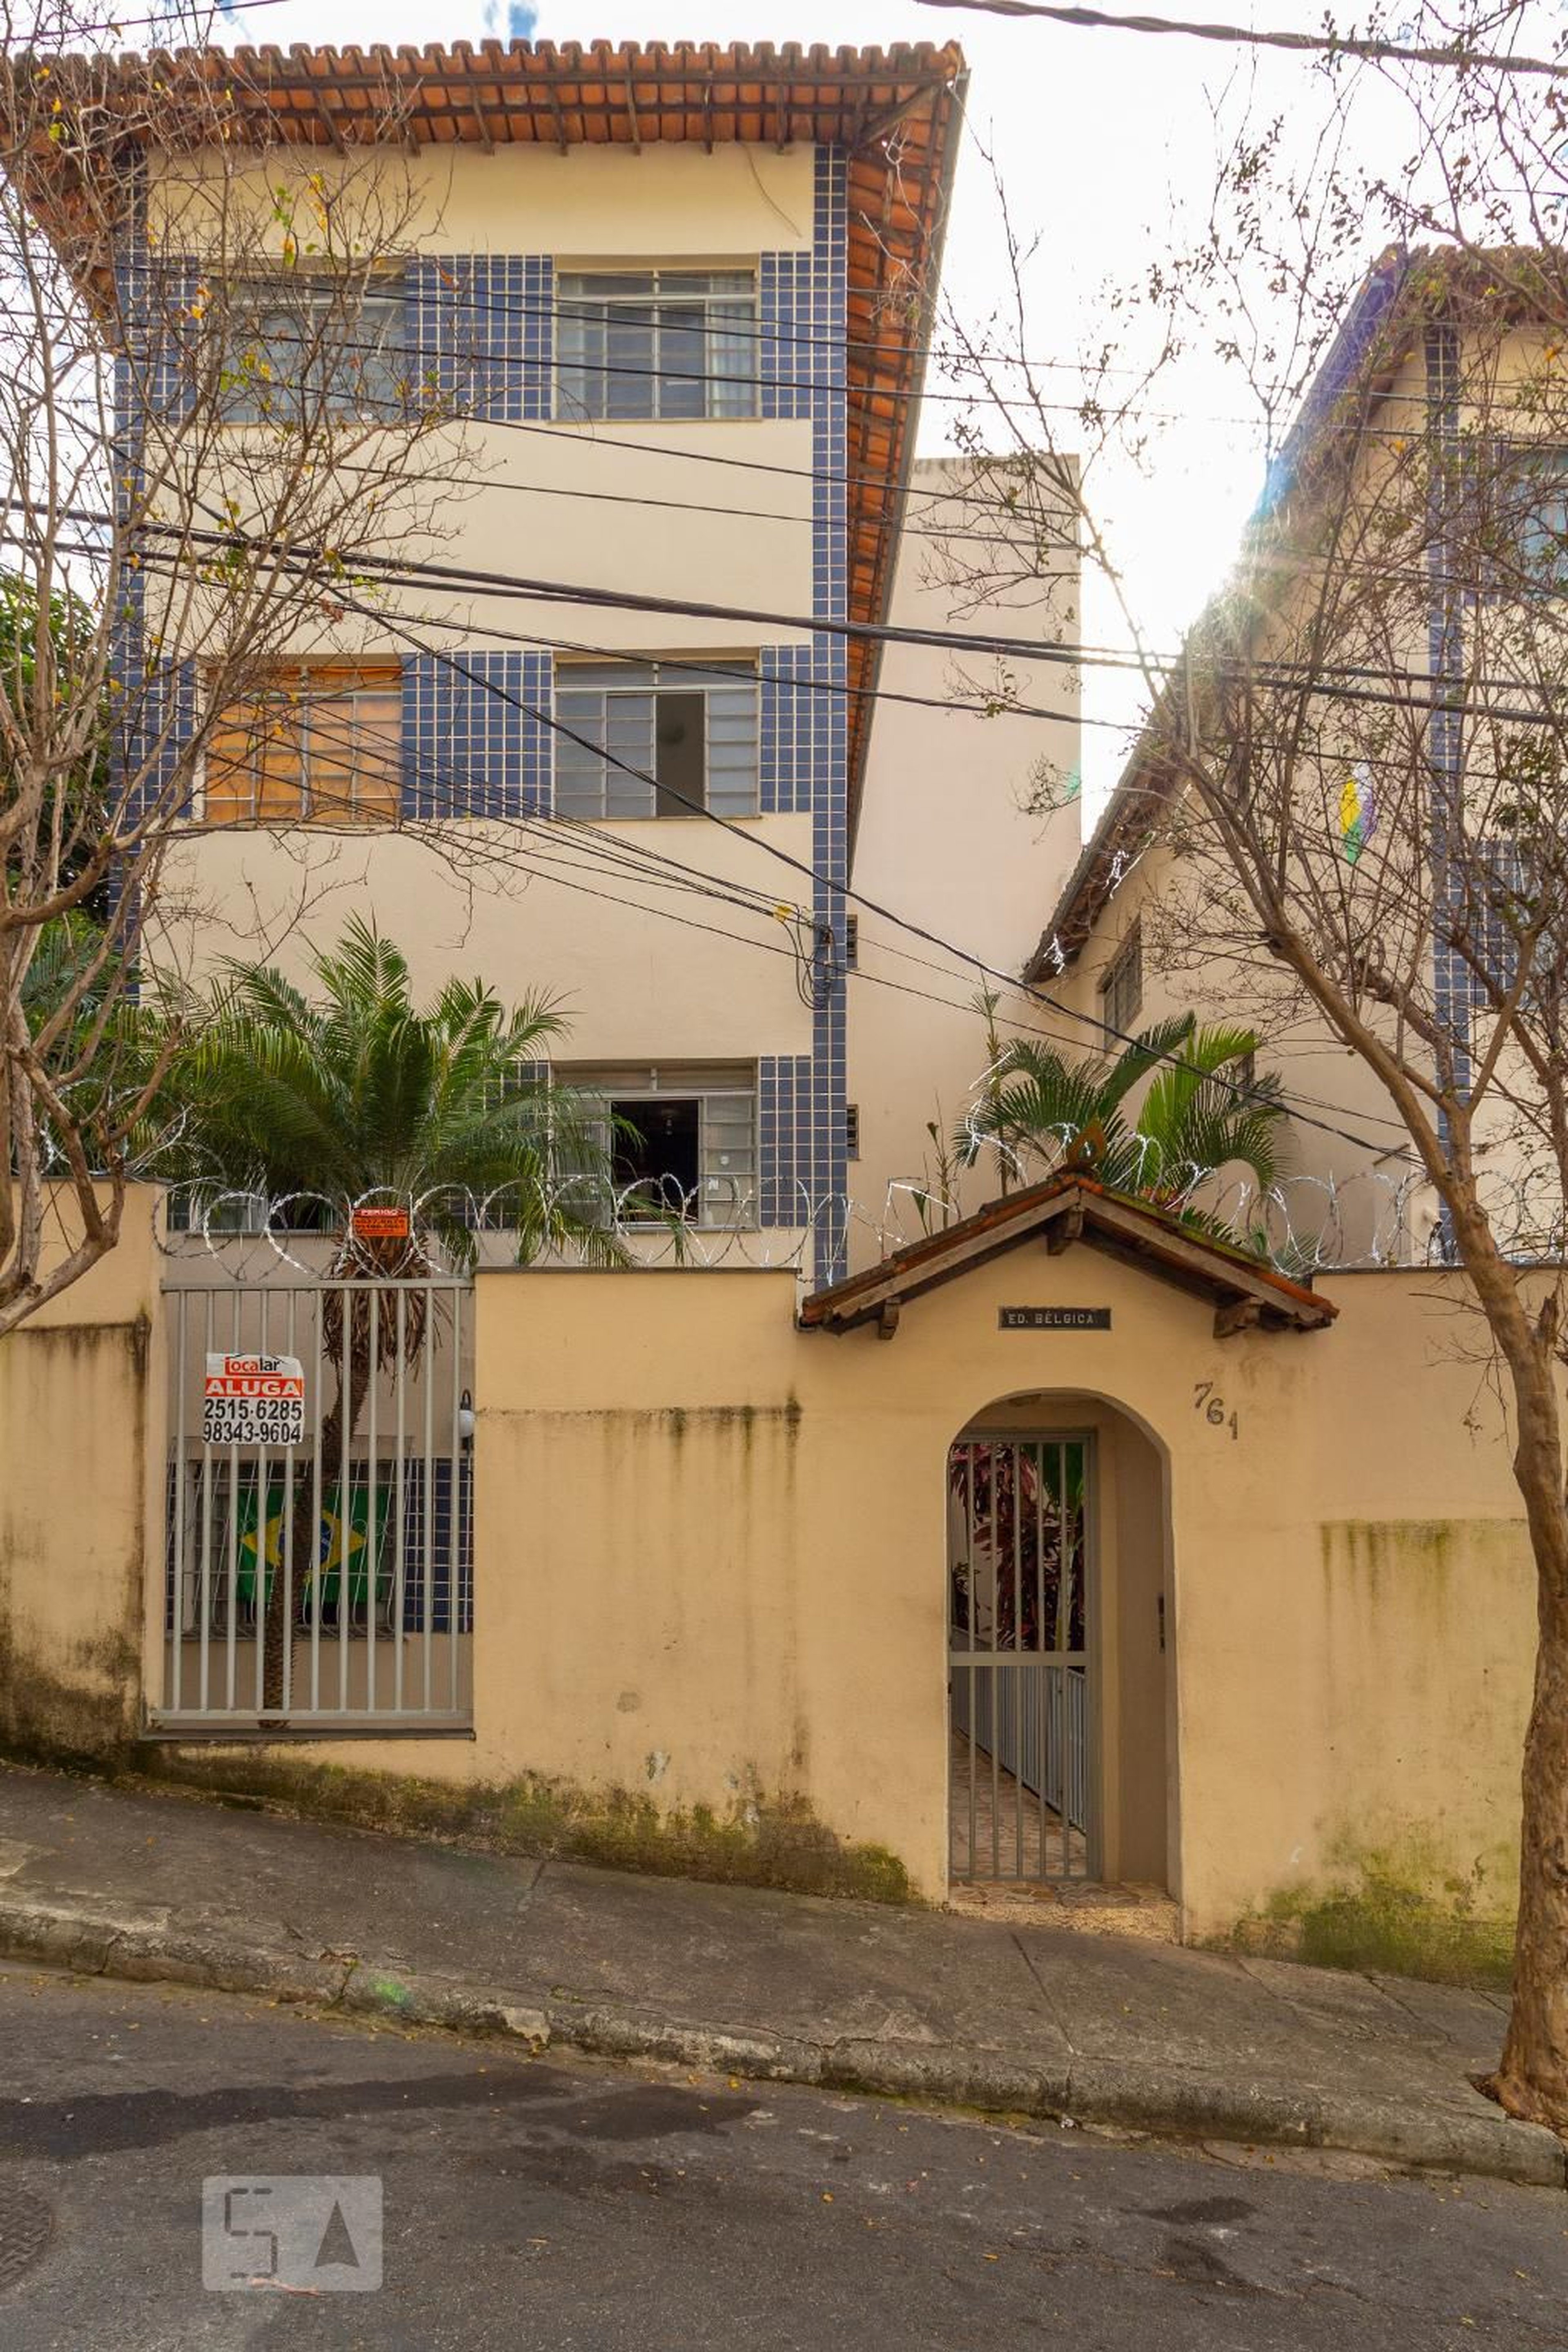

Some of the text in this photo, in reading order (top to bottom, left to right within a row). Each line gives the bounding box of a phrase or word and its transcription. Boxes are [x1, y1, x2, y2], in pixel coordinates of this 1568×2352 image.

[1009, 1314, 1028, 1324] ED.
[206, 1379, 301, 1396] ALUGA
[1194, 1381, 1238, 1440] 764
[203, 1421, 301, 1443] 98343-9604
